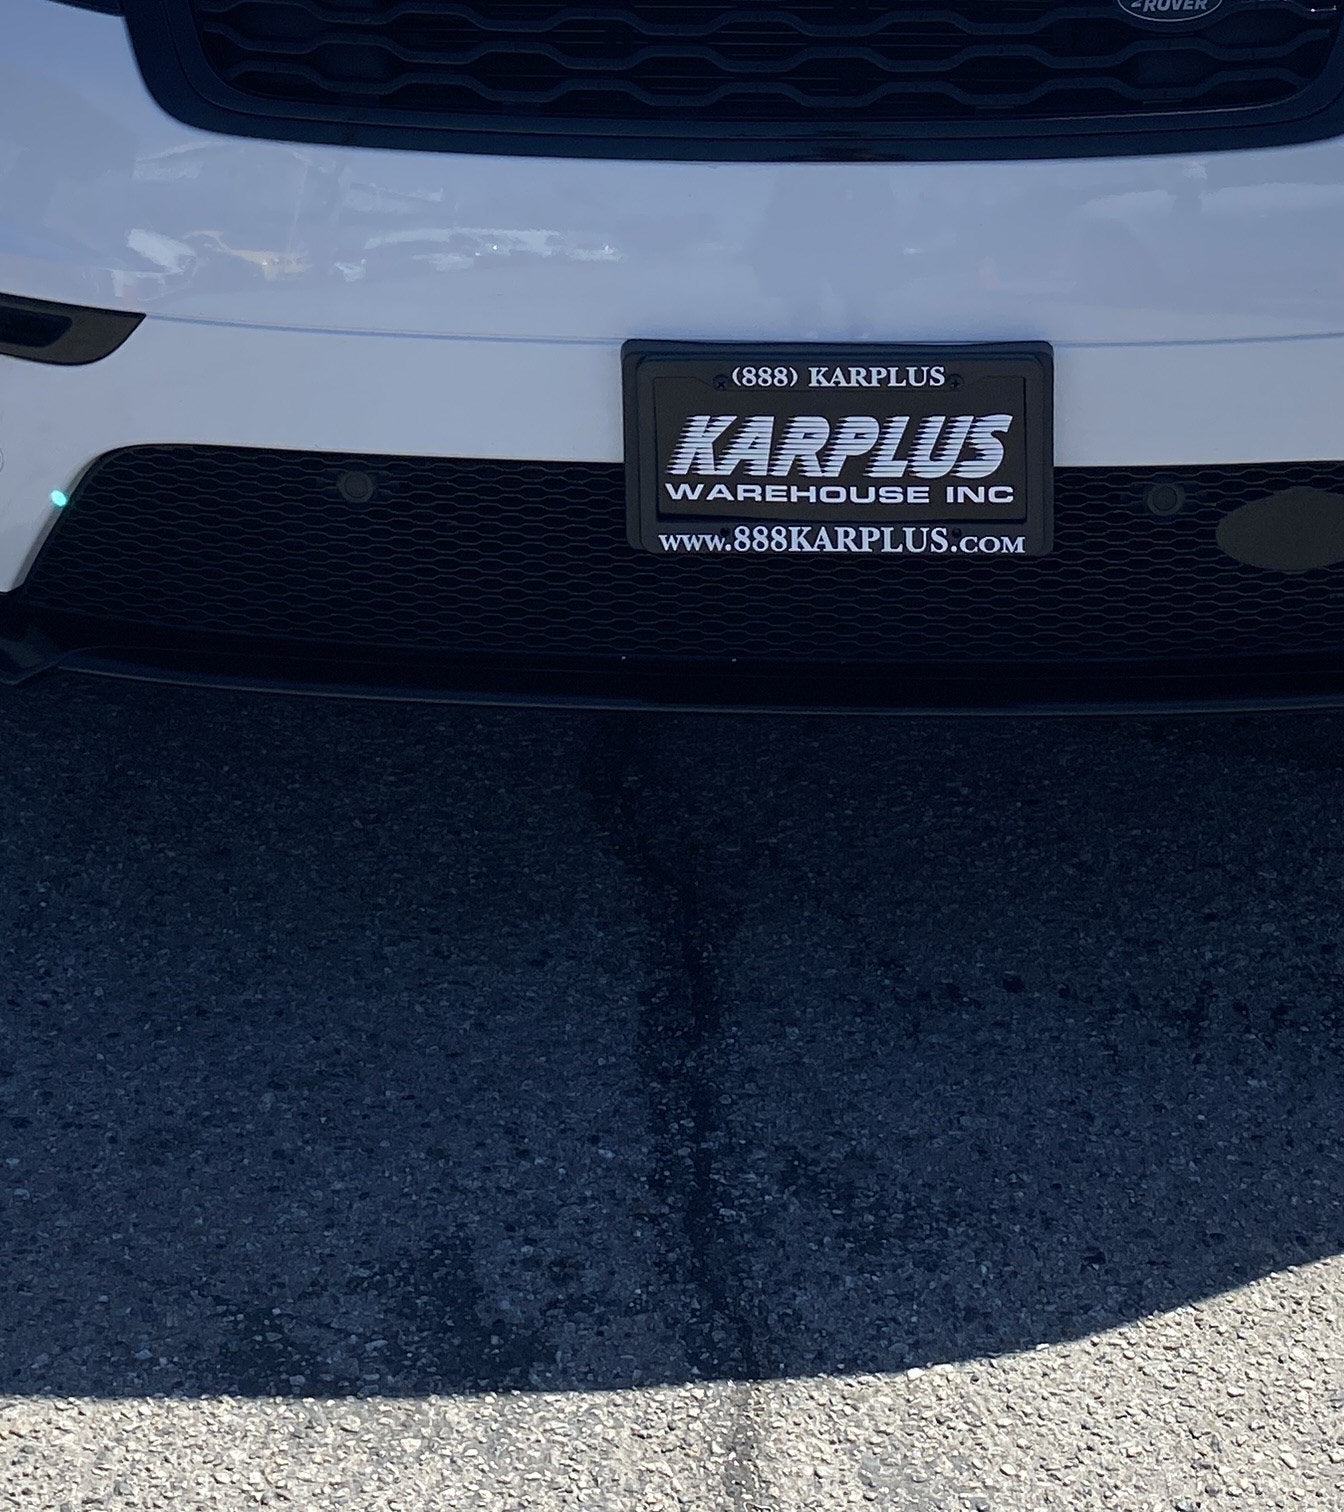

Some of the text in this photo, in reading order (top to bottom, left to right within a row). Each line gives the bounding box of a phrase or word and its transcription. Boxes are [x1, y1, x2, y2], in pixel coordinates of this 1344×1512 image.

[731, 366, 945, 387] (888) KARPLUS
[665, 413, 1013, 479] KARPLUS
[665, 482, 1014, 504] WAREHOUSE INC
